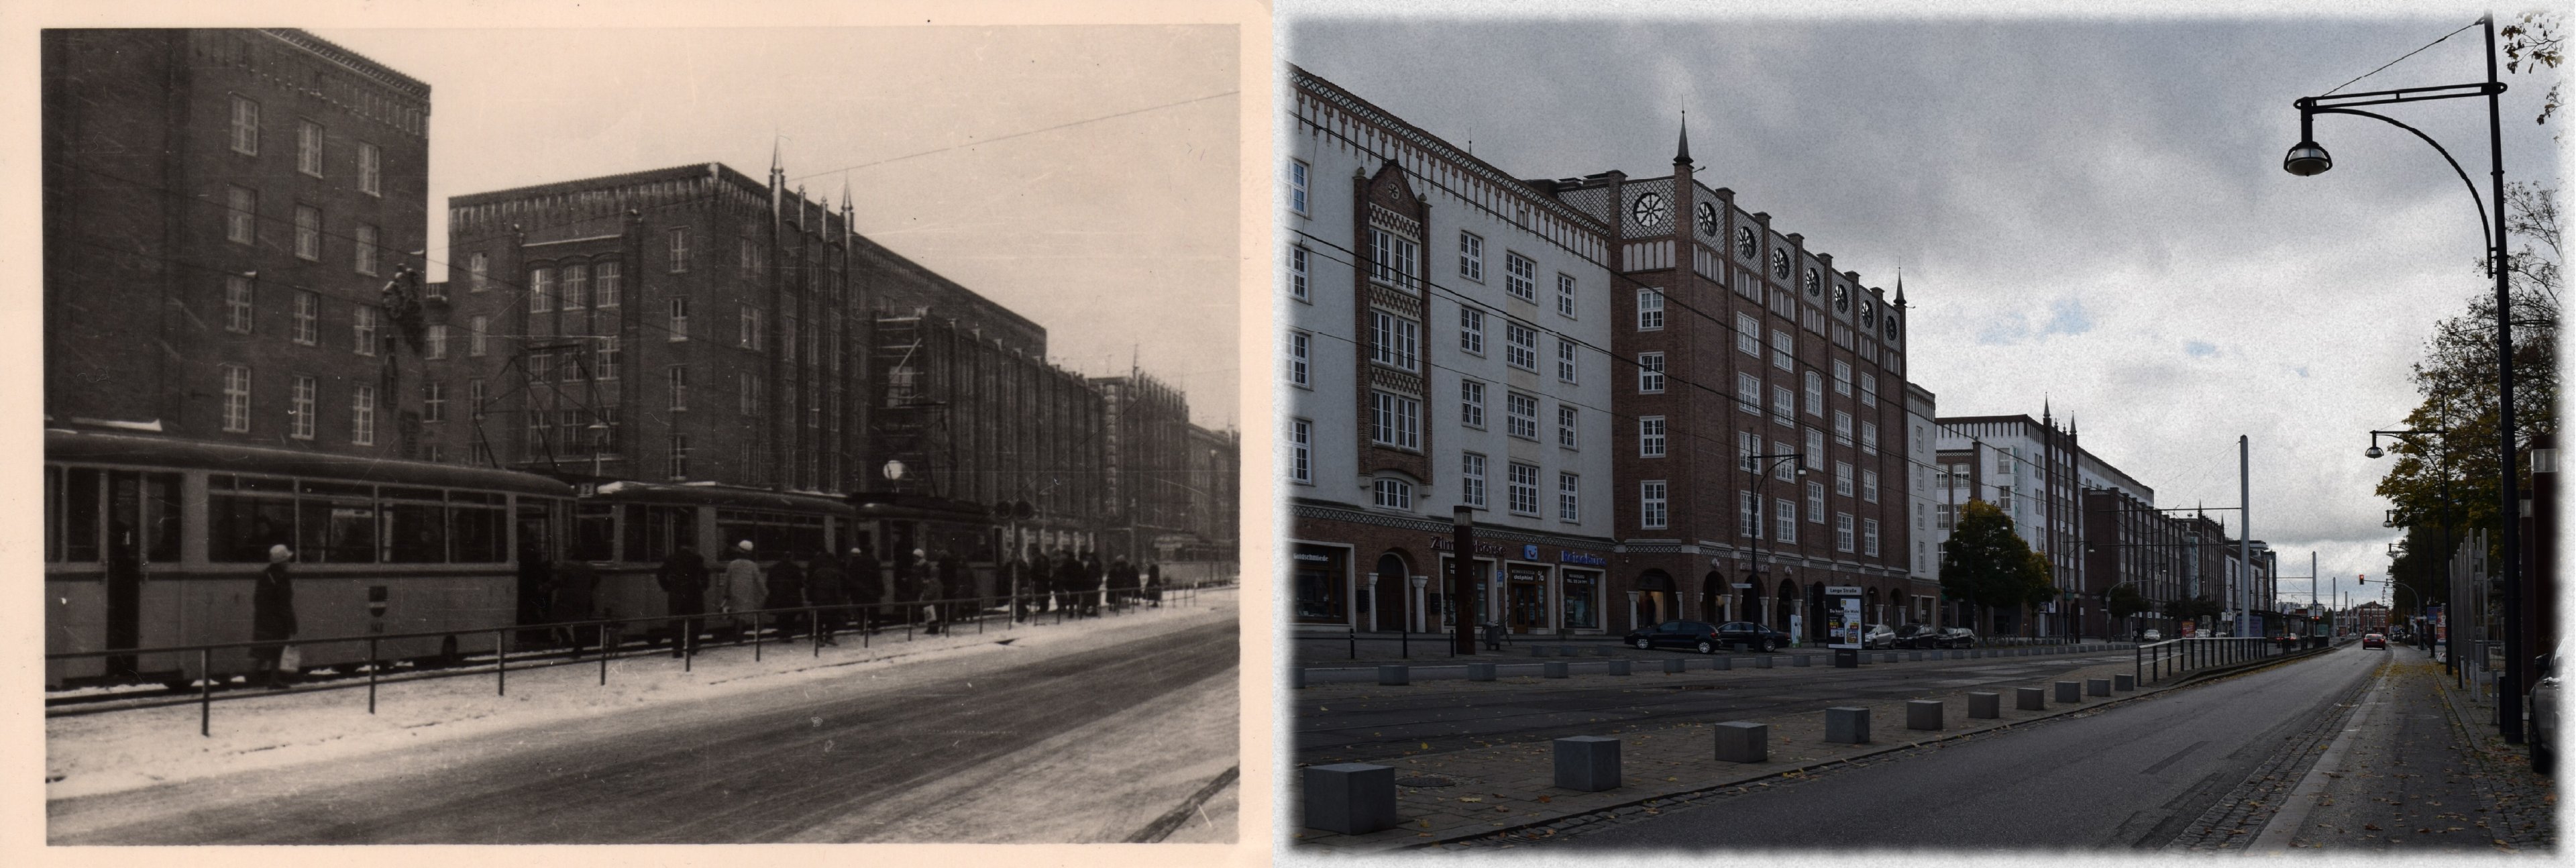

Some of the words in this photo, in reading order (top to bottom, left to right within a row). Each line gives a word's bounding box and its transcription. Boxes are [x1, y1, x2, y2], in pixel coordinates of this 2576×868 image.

[1430, 537, 1506, 555] Zimbörse
[1293, 553, 1328, 561] Goldschmiede
[1561, 550, 1607, 566] Reisebüro
